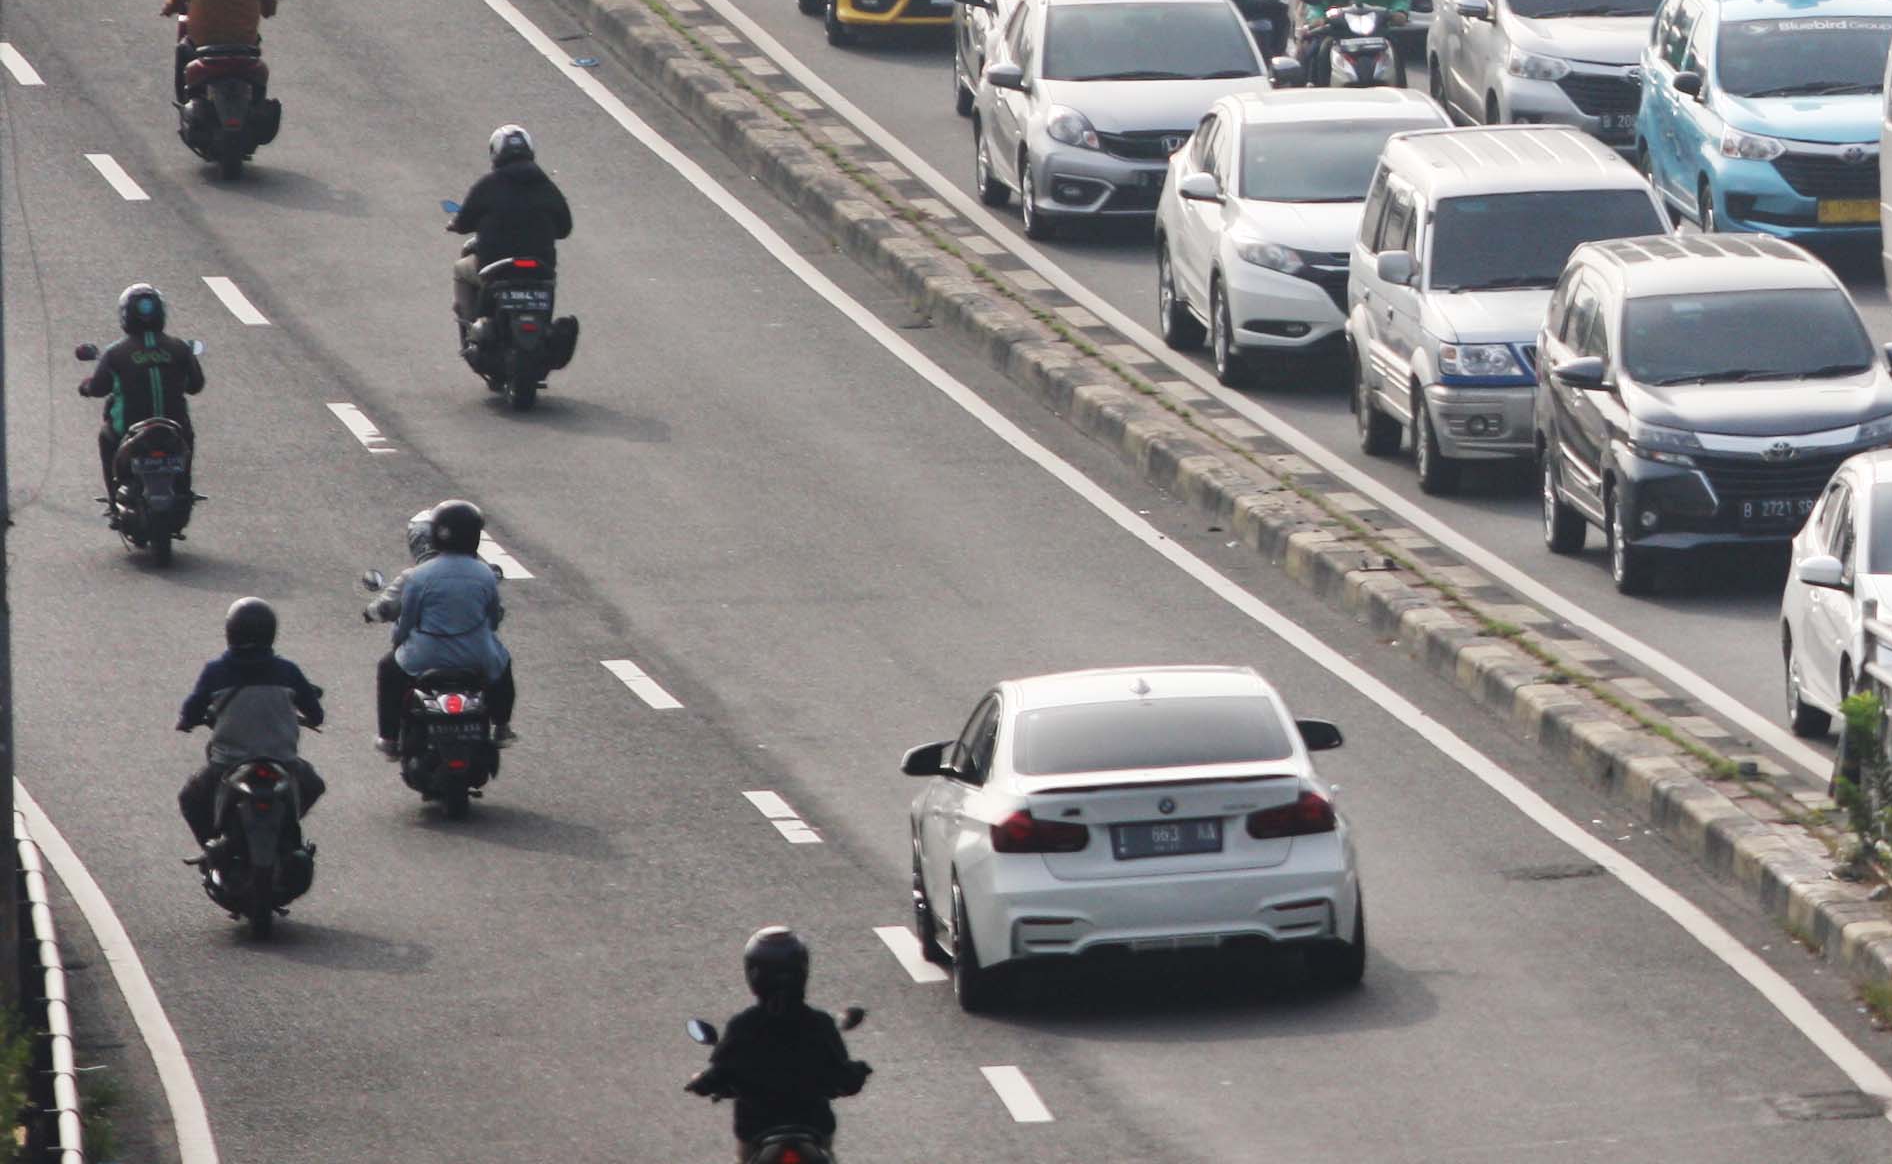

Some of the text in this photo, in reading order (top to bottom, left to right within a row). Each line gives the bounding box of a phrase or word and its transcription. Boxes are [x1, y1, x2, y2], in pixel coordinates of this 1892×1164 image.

[1778, 19, 1892, 32] Bluebird Group
[1744, 502, 1753, 518] B
